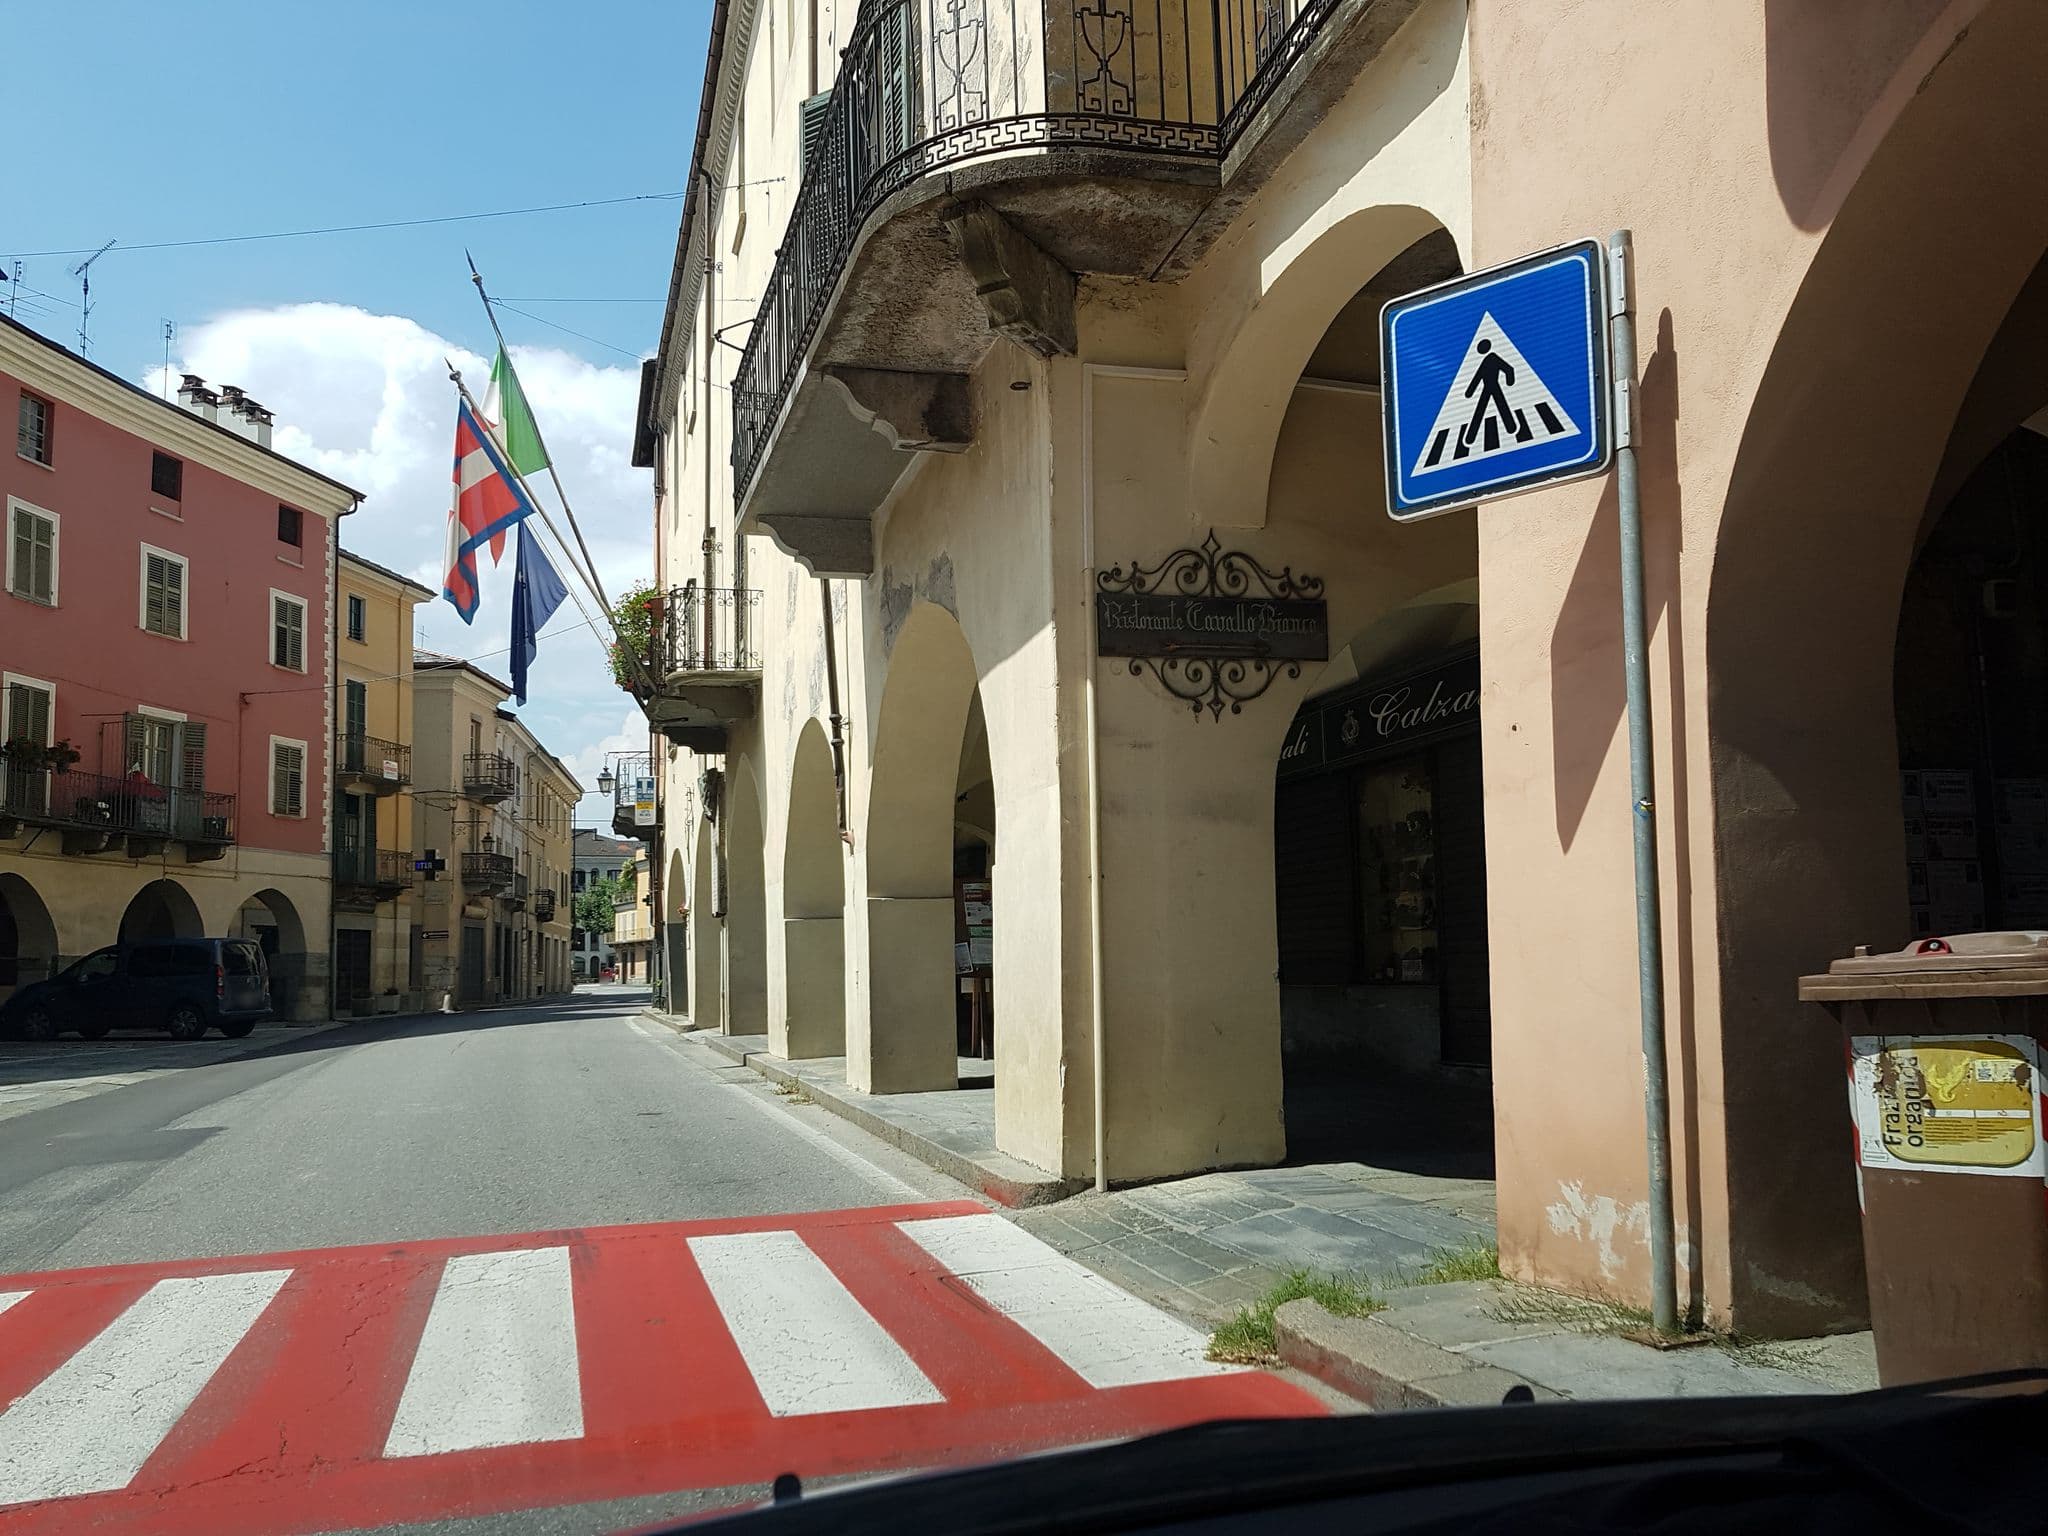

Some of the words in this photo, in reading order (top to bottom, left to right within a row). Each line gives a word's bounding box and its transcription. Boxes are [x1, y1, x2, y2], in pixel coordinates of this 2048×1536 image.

[1103, 598, 1185, 632] Ristorante
[1185, 599, 1257, 633] Cavallo
[1369, 680, 1481, 738] Calza
[1281, 724, 1309, 760] ali
